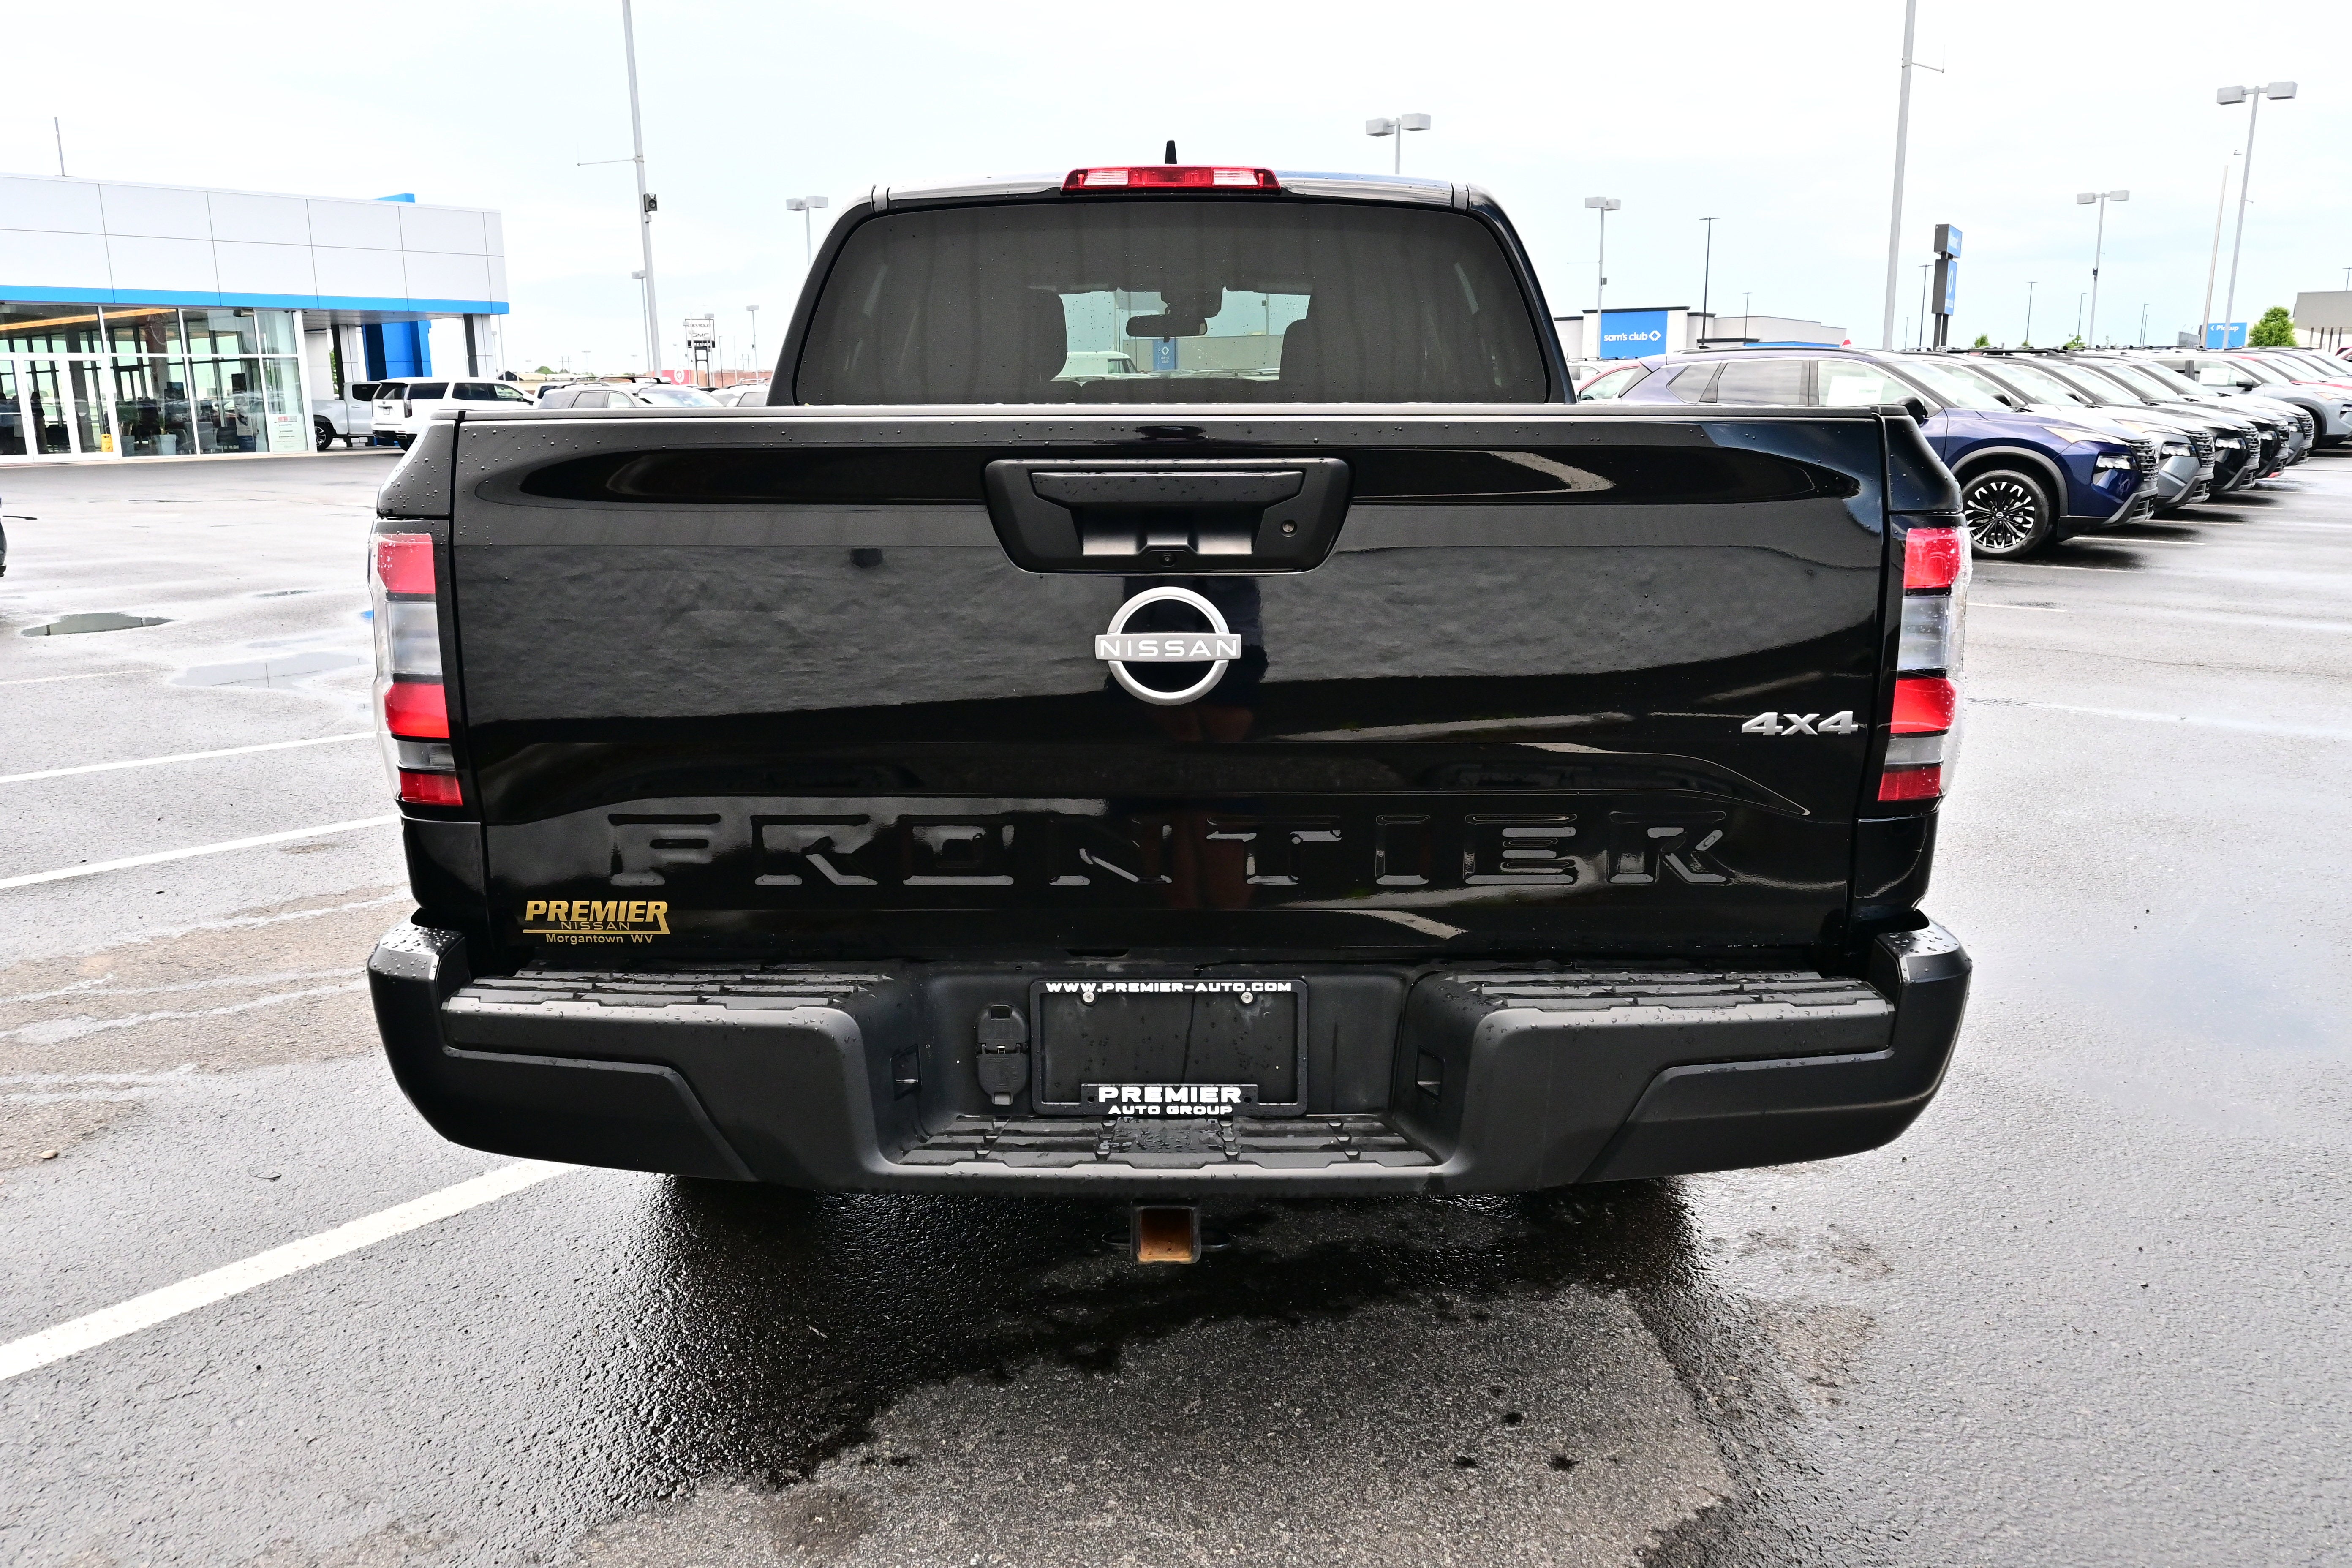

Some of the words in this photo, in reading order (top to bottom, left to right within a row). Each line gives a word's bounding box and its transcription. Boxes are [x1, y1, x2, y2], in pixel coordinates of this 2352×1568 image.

[2216, 324, 2239, 332] Picup
[1603, 332, 1628, 341] sam's
[1628, 332, 1648, 341] club
[1100, 639, 1237, 656] NISSAN
[607, 811, 1732, 886] FRONTIER
[525, 900, 669, 922] PREMIER
[561, 921, 630, 930] NISSAN
[546, 934, 623, 945] Morgantown
[631, 934, 653, 943] WV
[1045, 982, 1292, 992] WWW.PREMIER-AUTO.COM
[1098, 1086, 1241, 1103] PREMIER
[1108, 1105, 1161, 1115] AUTO
[1166, 1105, 1233, 1115] GROUP
